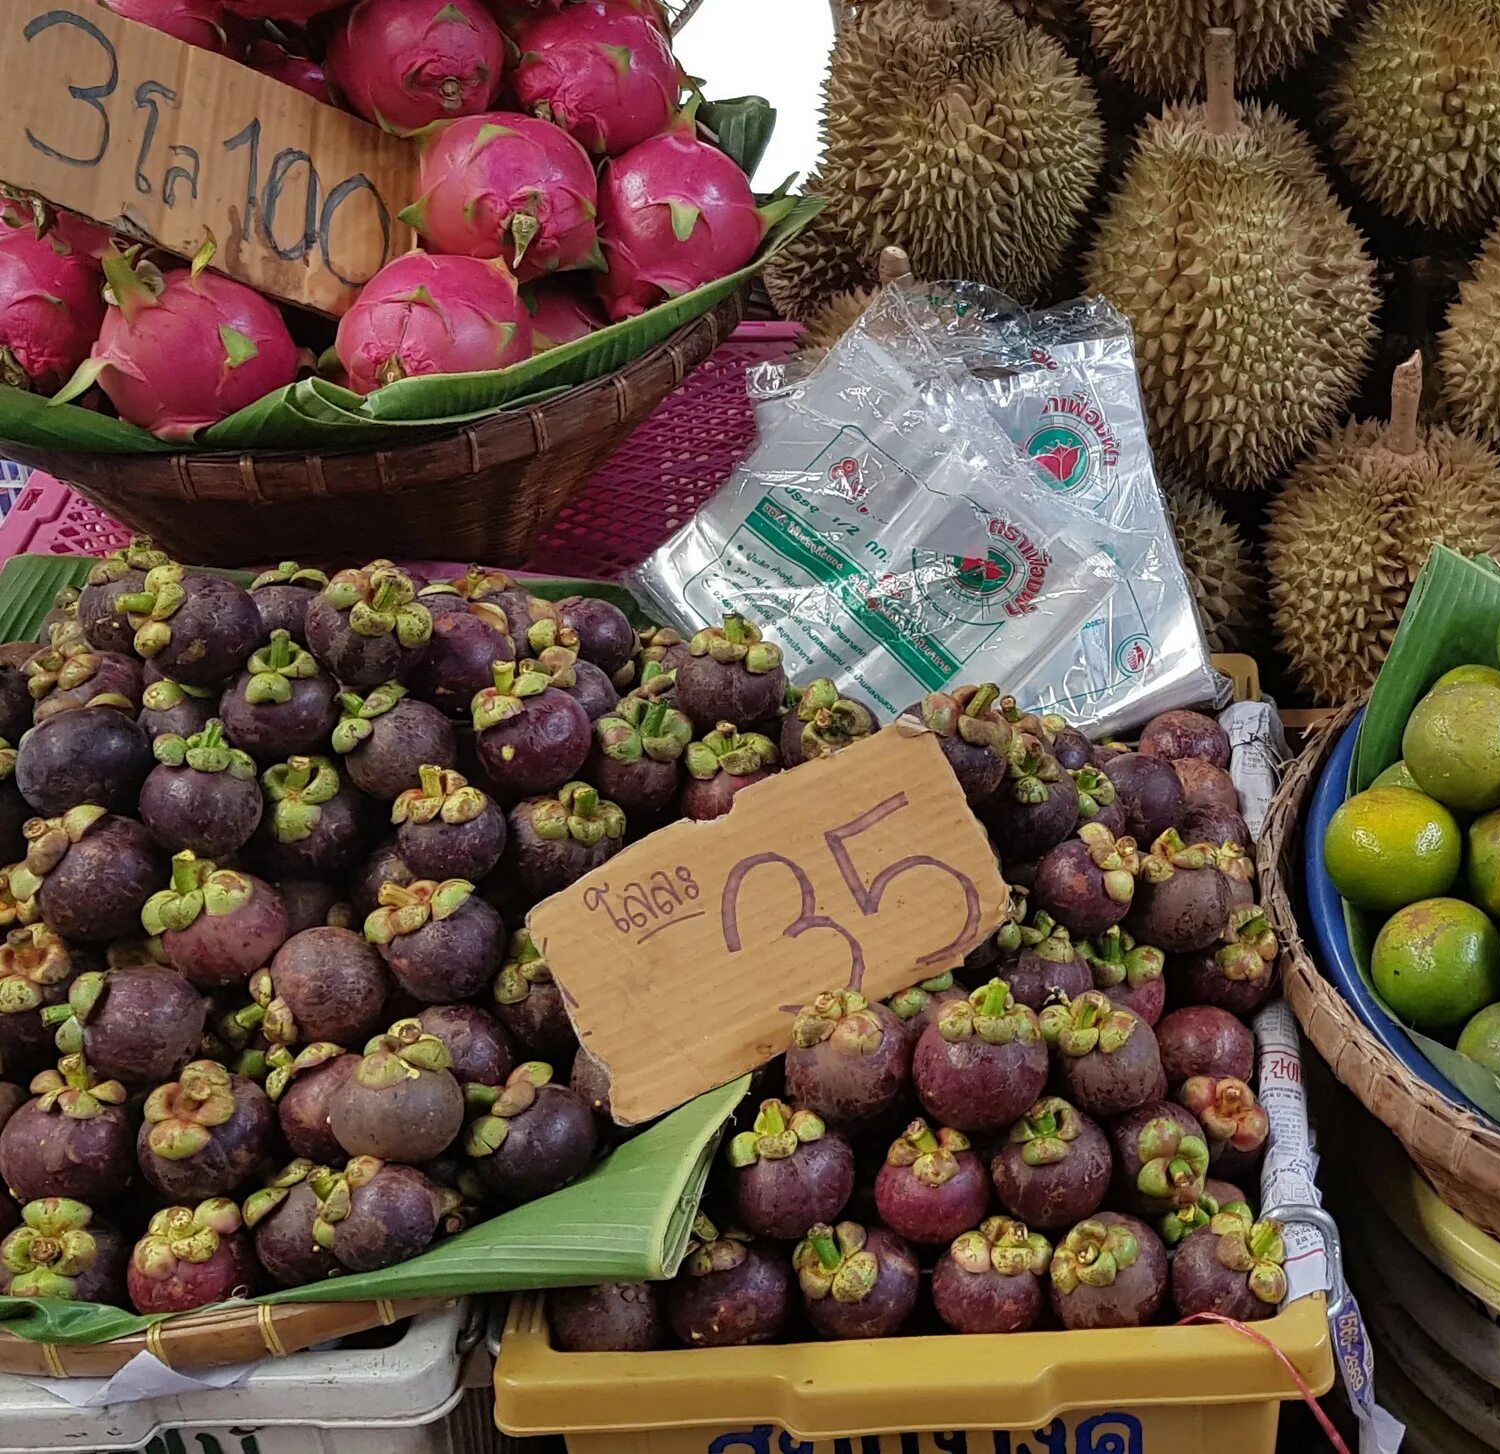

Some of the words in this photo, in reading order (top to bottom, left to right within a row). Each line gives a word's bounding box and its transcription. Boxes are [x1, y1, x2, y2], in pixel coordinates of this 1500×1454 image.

[22, 9, 119, 168] 3
[133, 79, 201, 210] โล
[223, 117, 391, 288] 100
[832, 516, 860, 537] 1/2
[583, 864, 701, 936] โลละ
[721, 790, 981, 1015] 35
